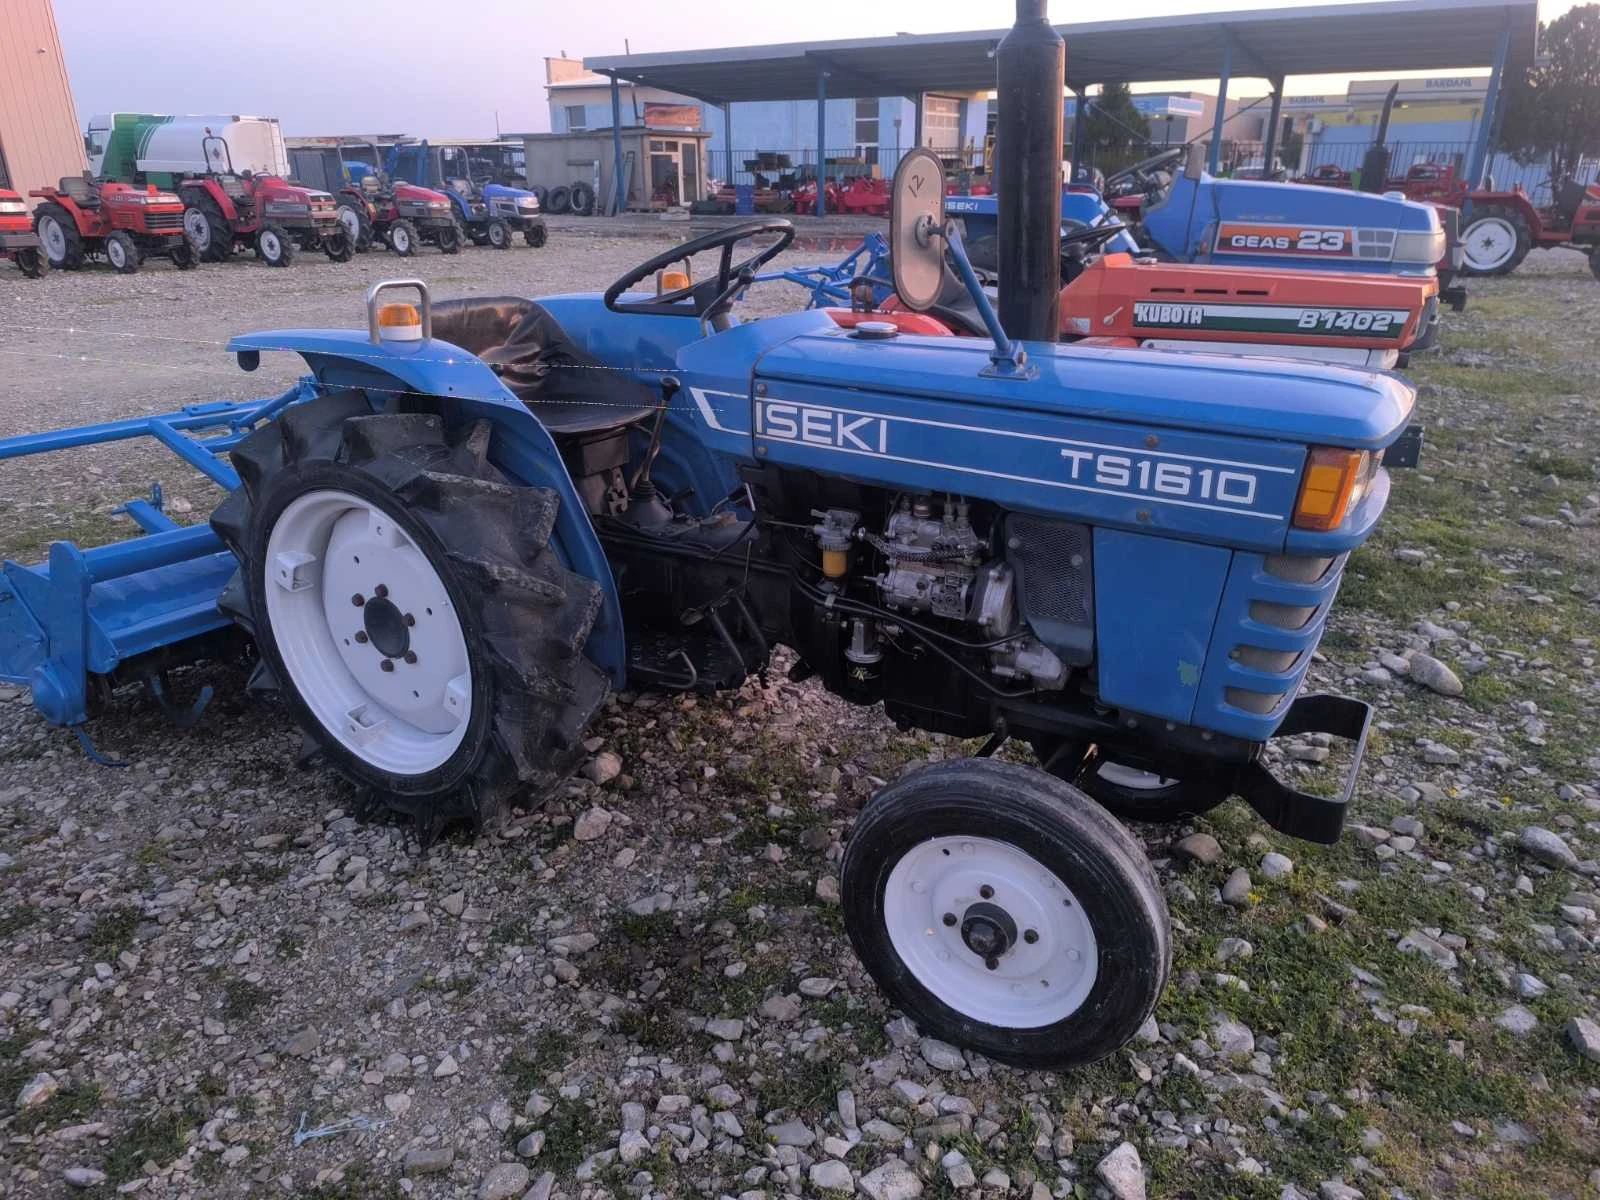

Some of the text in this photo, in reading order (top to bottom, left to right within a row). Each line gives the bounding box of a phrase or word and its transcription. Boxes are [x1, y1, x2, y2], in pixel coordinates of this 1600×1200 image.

[908, 174, 926, 198] 12
[1231, 230, 1345, 252] GEAS 23
[1136, 304, 1205, 325] KUBOTA
[1297, 310, 1393, 332] B1402
[756, 400, 886, 453] ISEKI
[1060, 448, 1256, 505] TS1610
